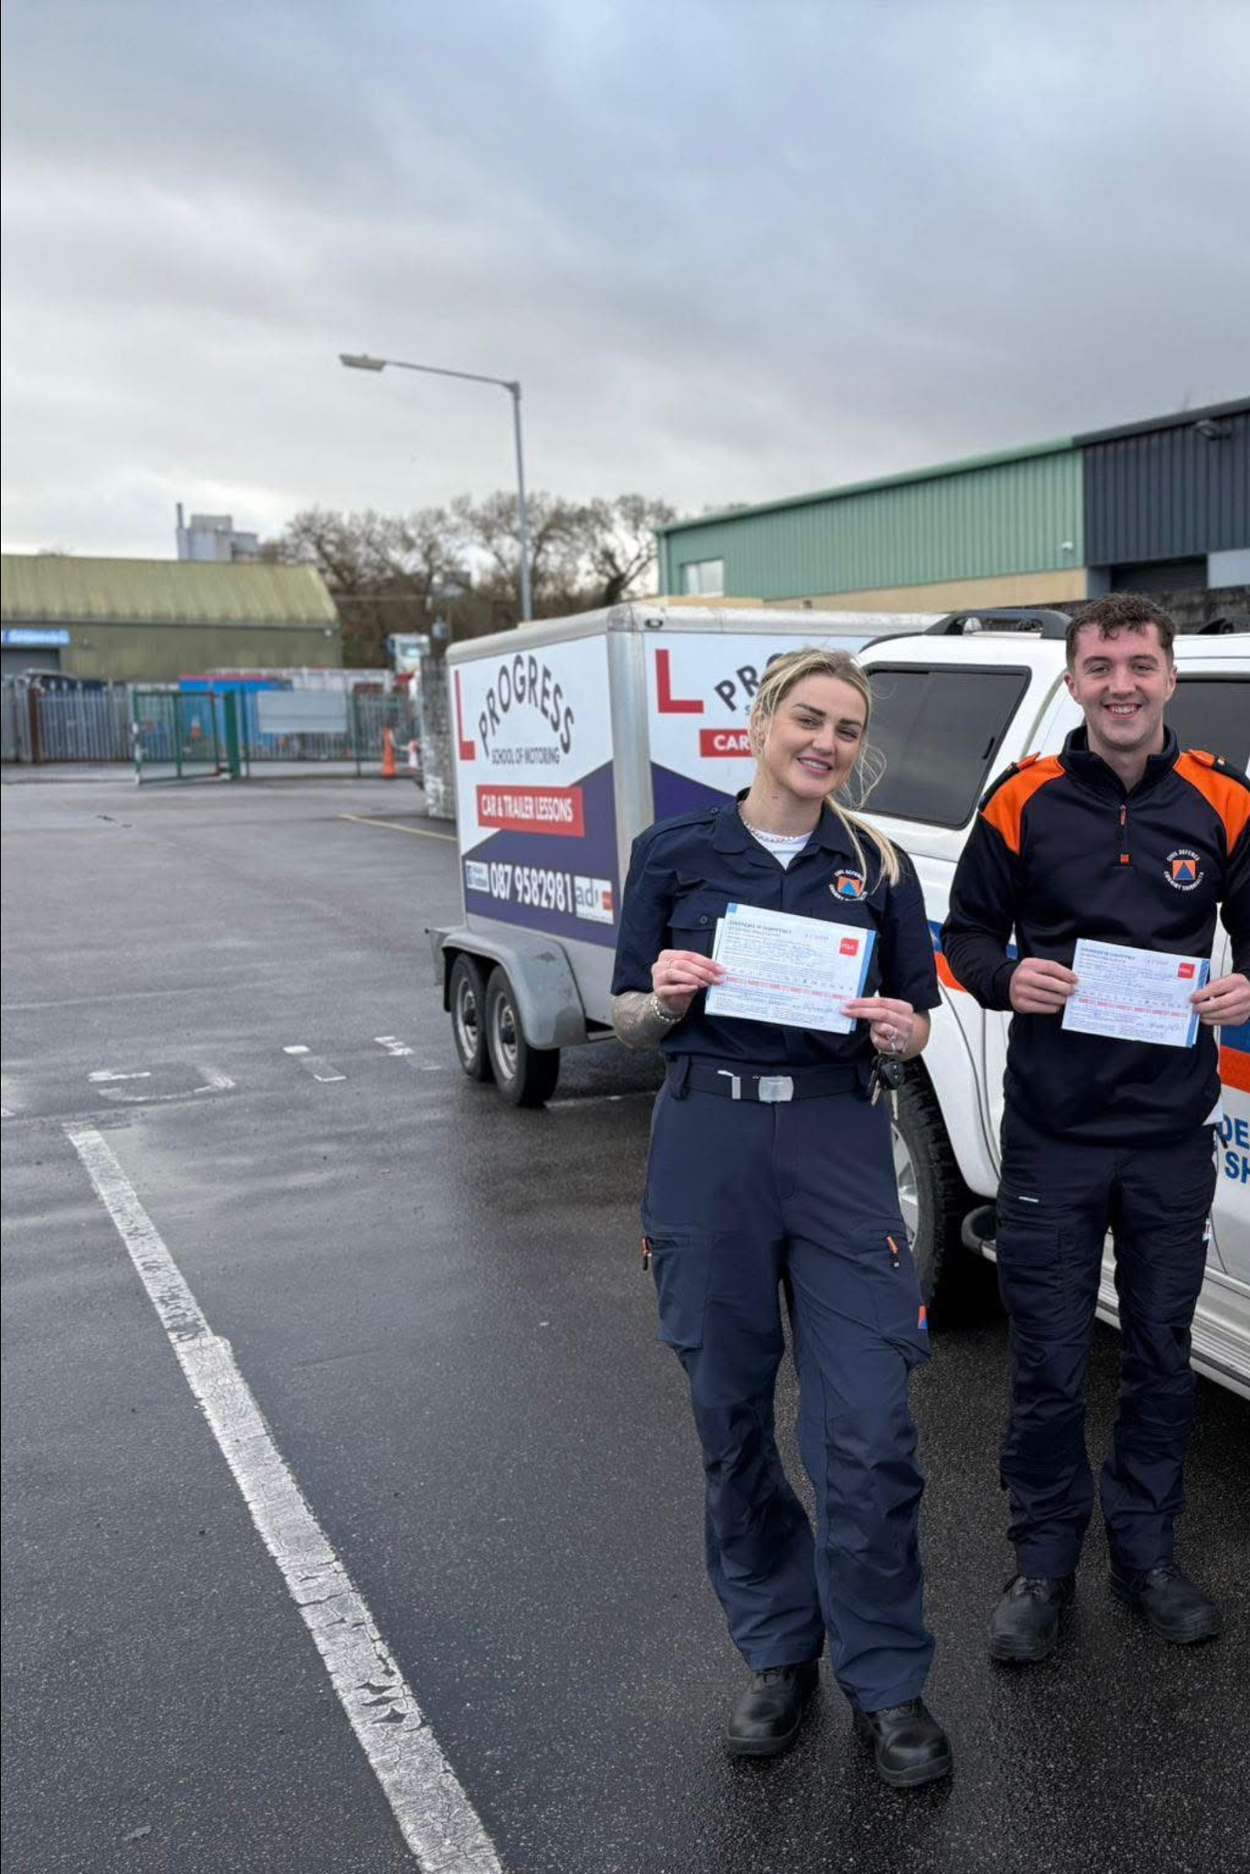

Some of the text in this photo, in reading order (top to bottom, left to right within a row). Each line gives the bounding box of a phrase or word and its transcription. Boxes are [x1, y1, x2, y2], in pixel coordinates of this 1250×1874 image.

[479, 654, 575, 758] PROGRESS
[655, 649, 704, 713] L
[454, 670, 475, 761] L
[491, 746, 560, 765] SCHOOL OF MOTORING
[713, 734, 750, 751] CAR
[481, 794, 497, 818] CAR
[503, 795, 535, 820] TRAILER
[535, 796, 574, 822] LESSONS
[490, 862, 512, 899] 087
[514, 866, 573, 914] 9582981
